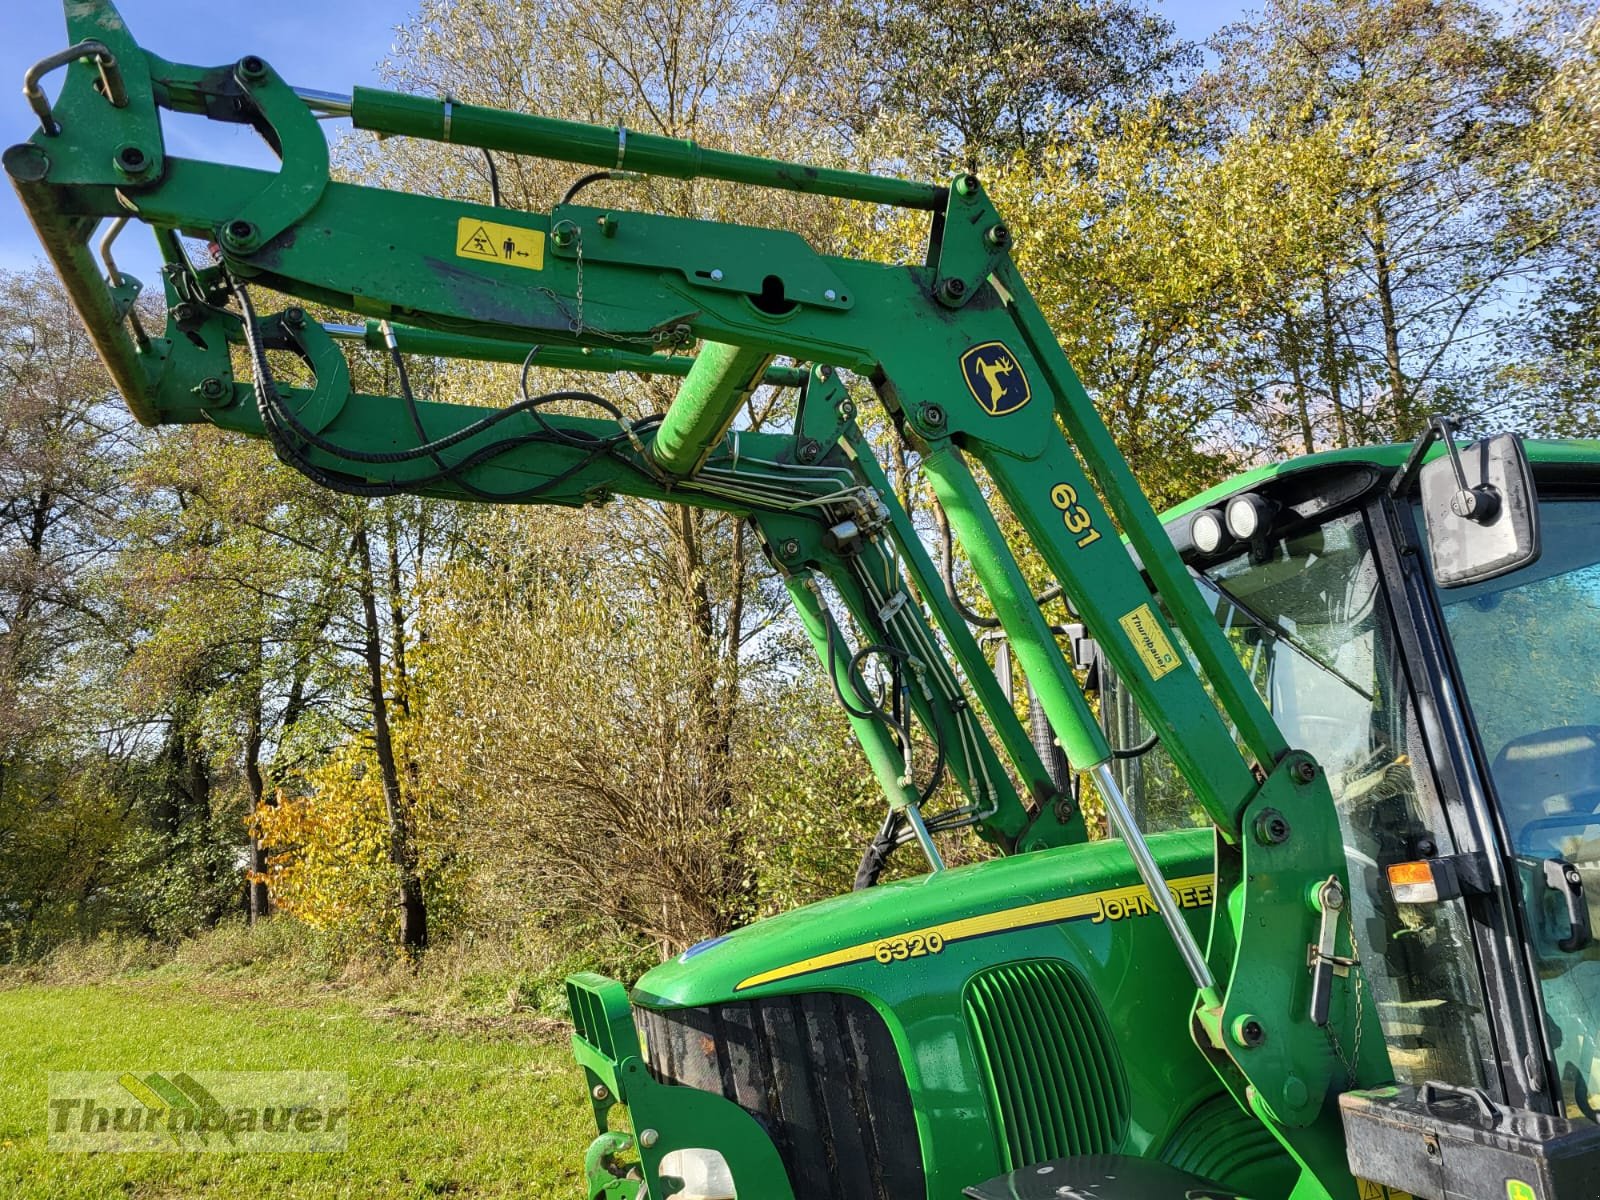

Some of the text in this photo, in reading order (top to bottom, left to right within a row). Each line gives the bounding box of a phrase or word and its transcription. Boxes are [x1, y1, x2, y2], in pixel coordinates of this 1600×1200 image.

[1051, 483, 1101, 549] 631
[1132, 614, 1167, 668] Thurnbauer
[875, 932, 944, 965] 6320
